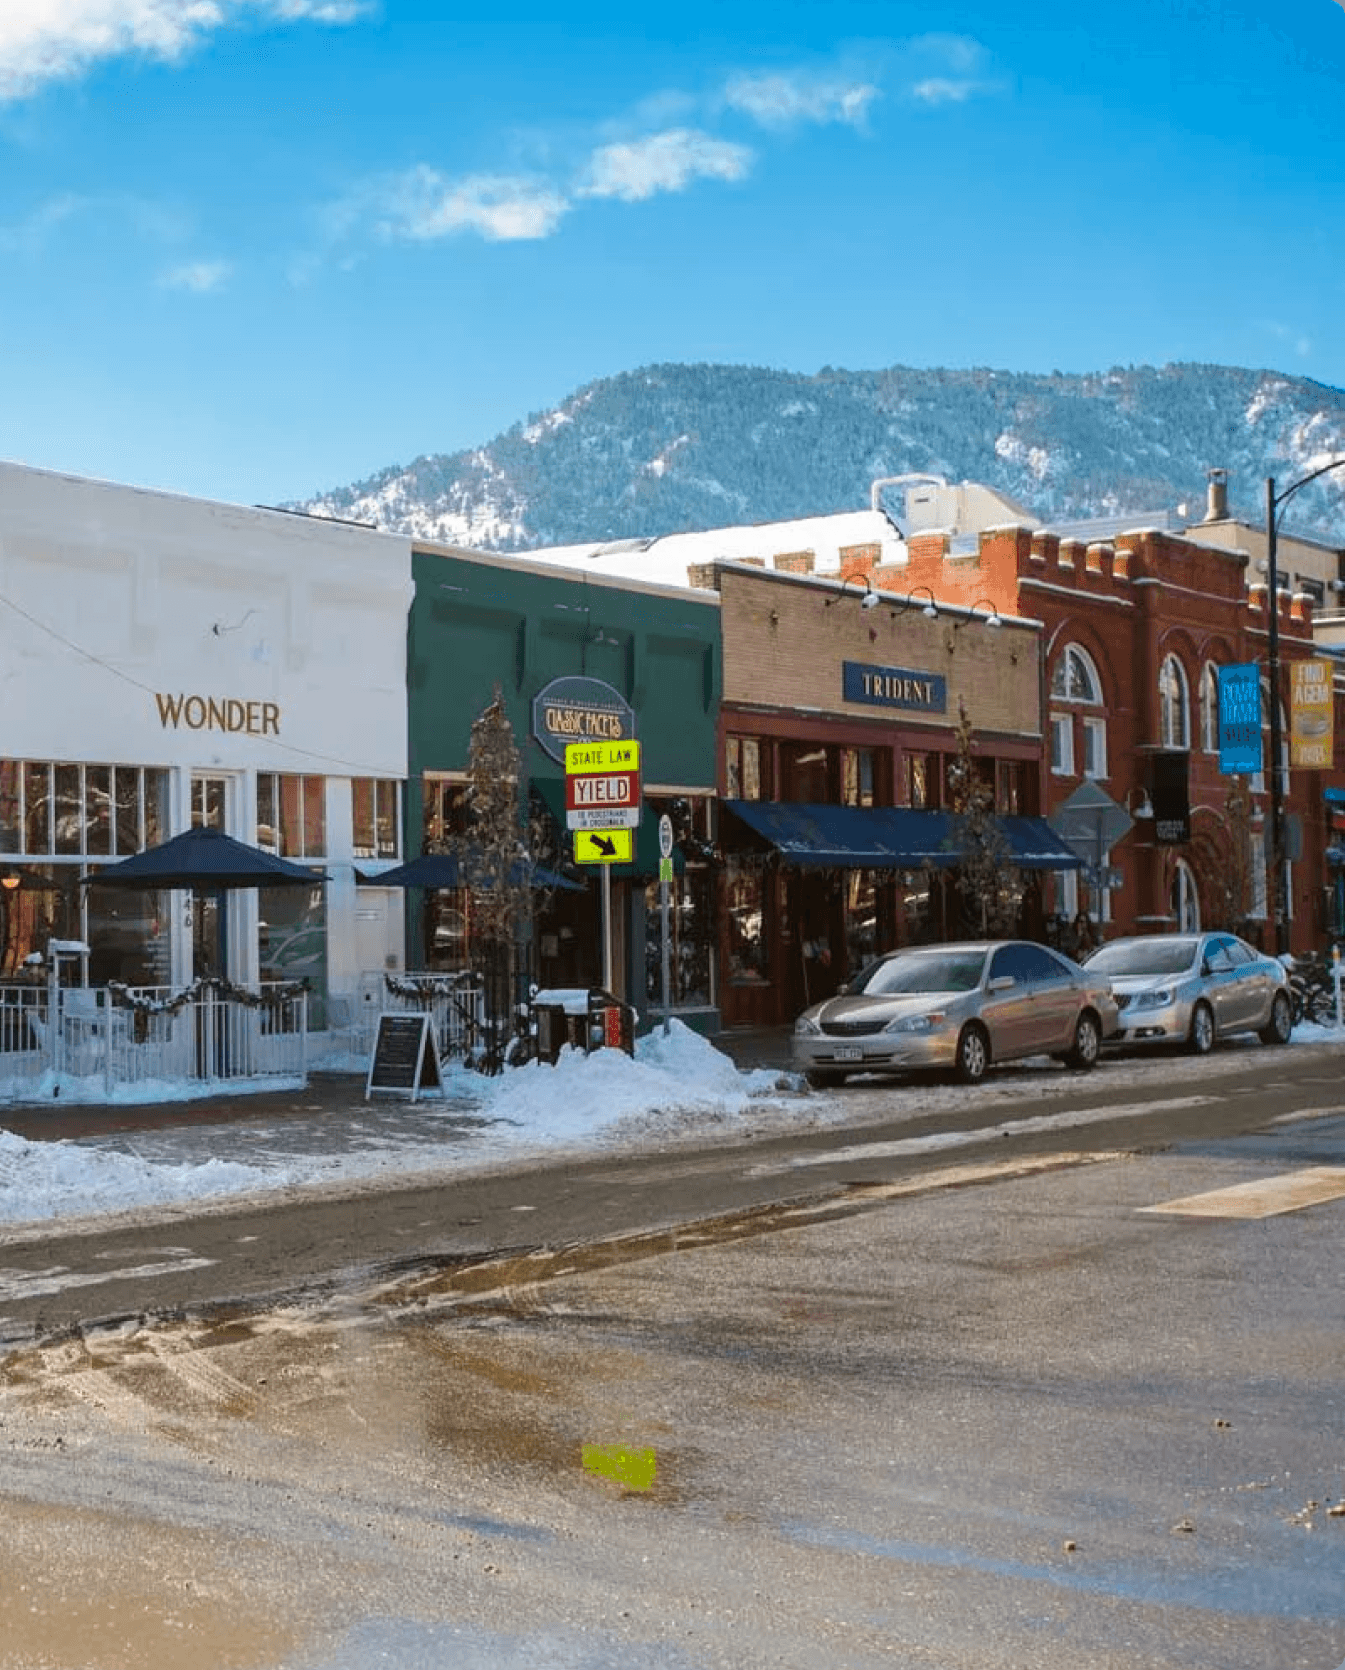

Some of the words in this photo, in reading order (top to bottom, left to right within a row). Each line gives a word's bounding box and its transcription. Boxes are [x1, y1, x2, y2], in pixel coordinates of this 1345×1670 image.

[862, 673, 933, 704] TRIDENT
[155, 693, 280, 735] WONDER
[572, 750, 604, 765] STATE
[609, 749, 633, 763] LAW
[577, 779, 628, 802] YIELD
